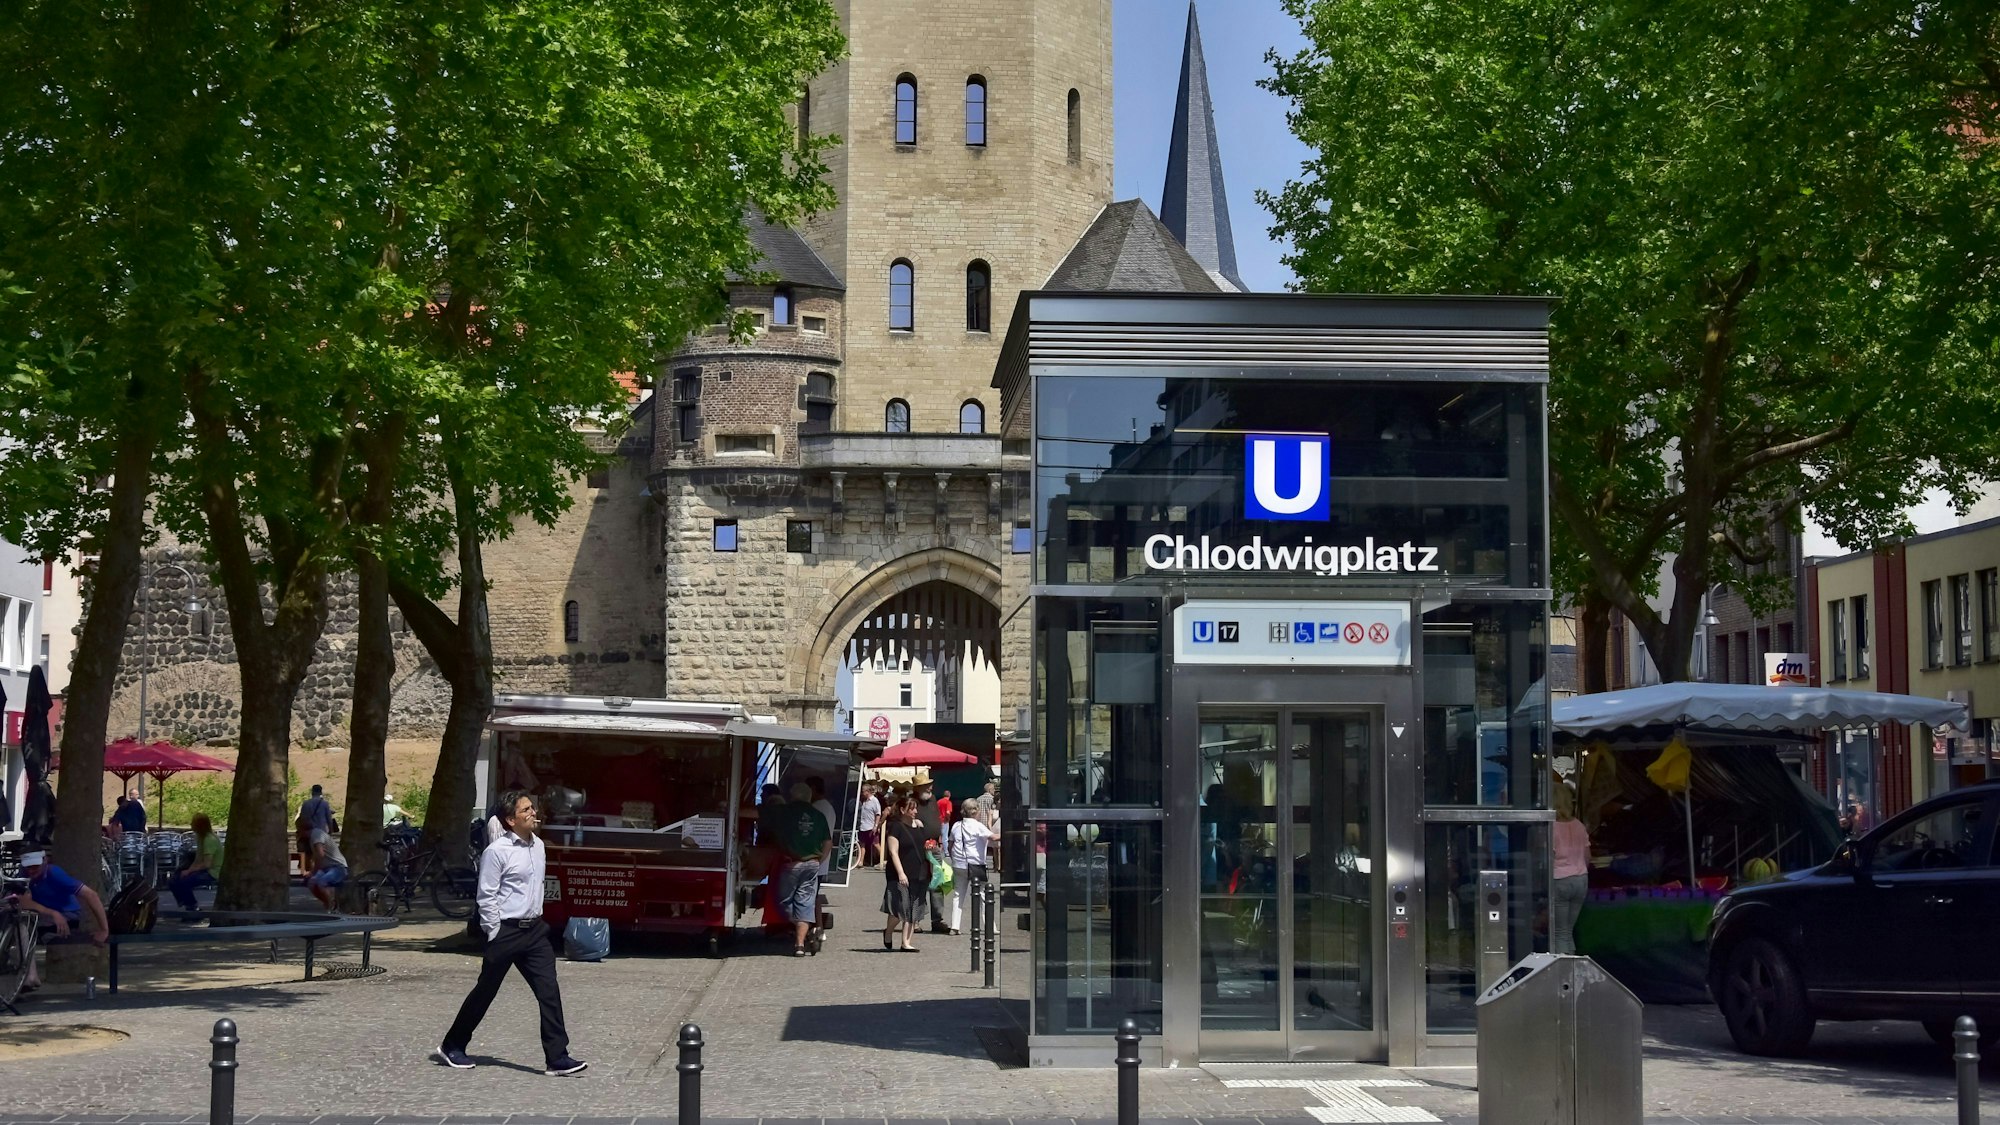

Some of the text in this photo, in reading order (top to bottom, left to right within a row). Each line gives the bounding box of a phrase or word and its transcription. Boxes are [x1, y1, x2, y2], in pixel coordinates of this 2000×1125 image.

[1254, 440, 1322, 514] U
[1144, 534, 1439, 576] Chlodwigplatz
[1195, 622, 1237, 640] U 17
[1776, 658, 1803, 674] dm
[567, 868, 626, 878] Kirchheimerstr.
[568, 877, 635, 887] 53881 Euskirchen
